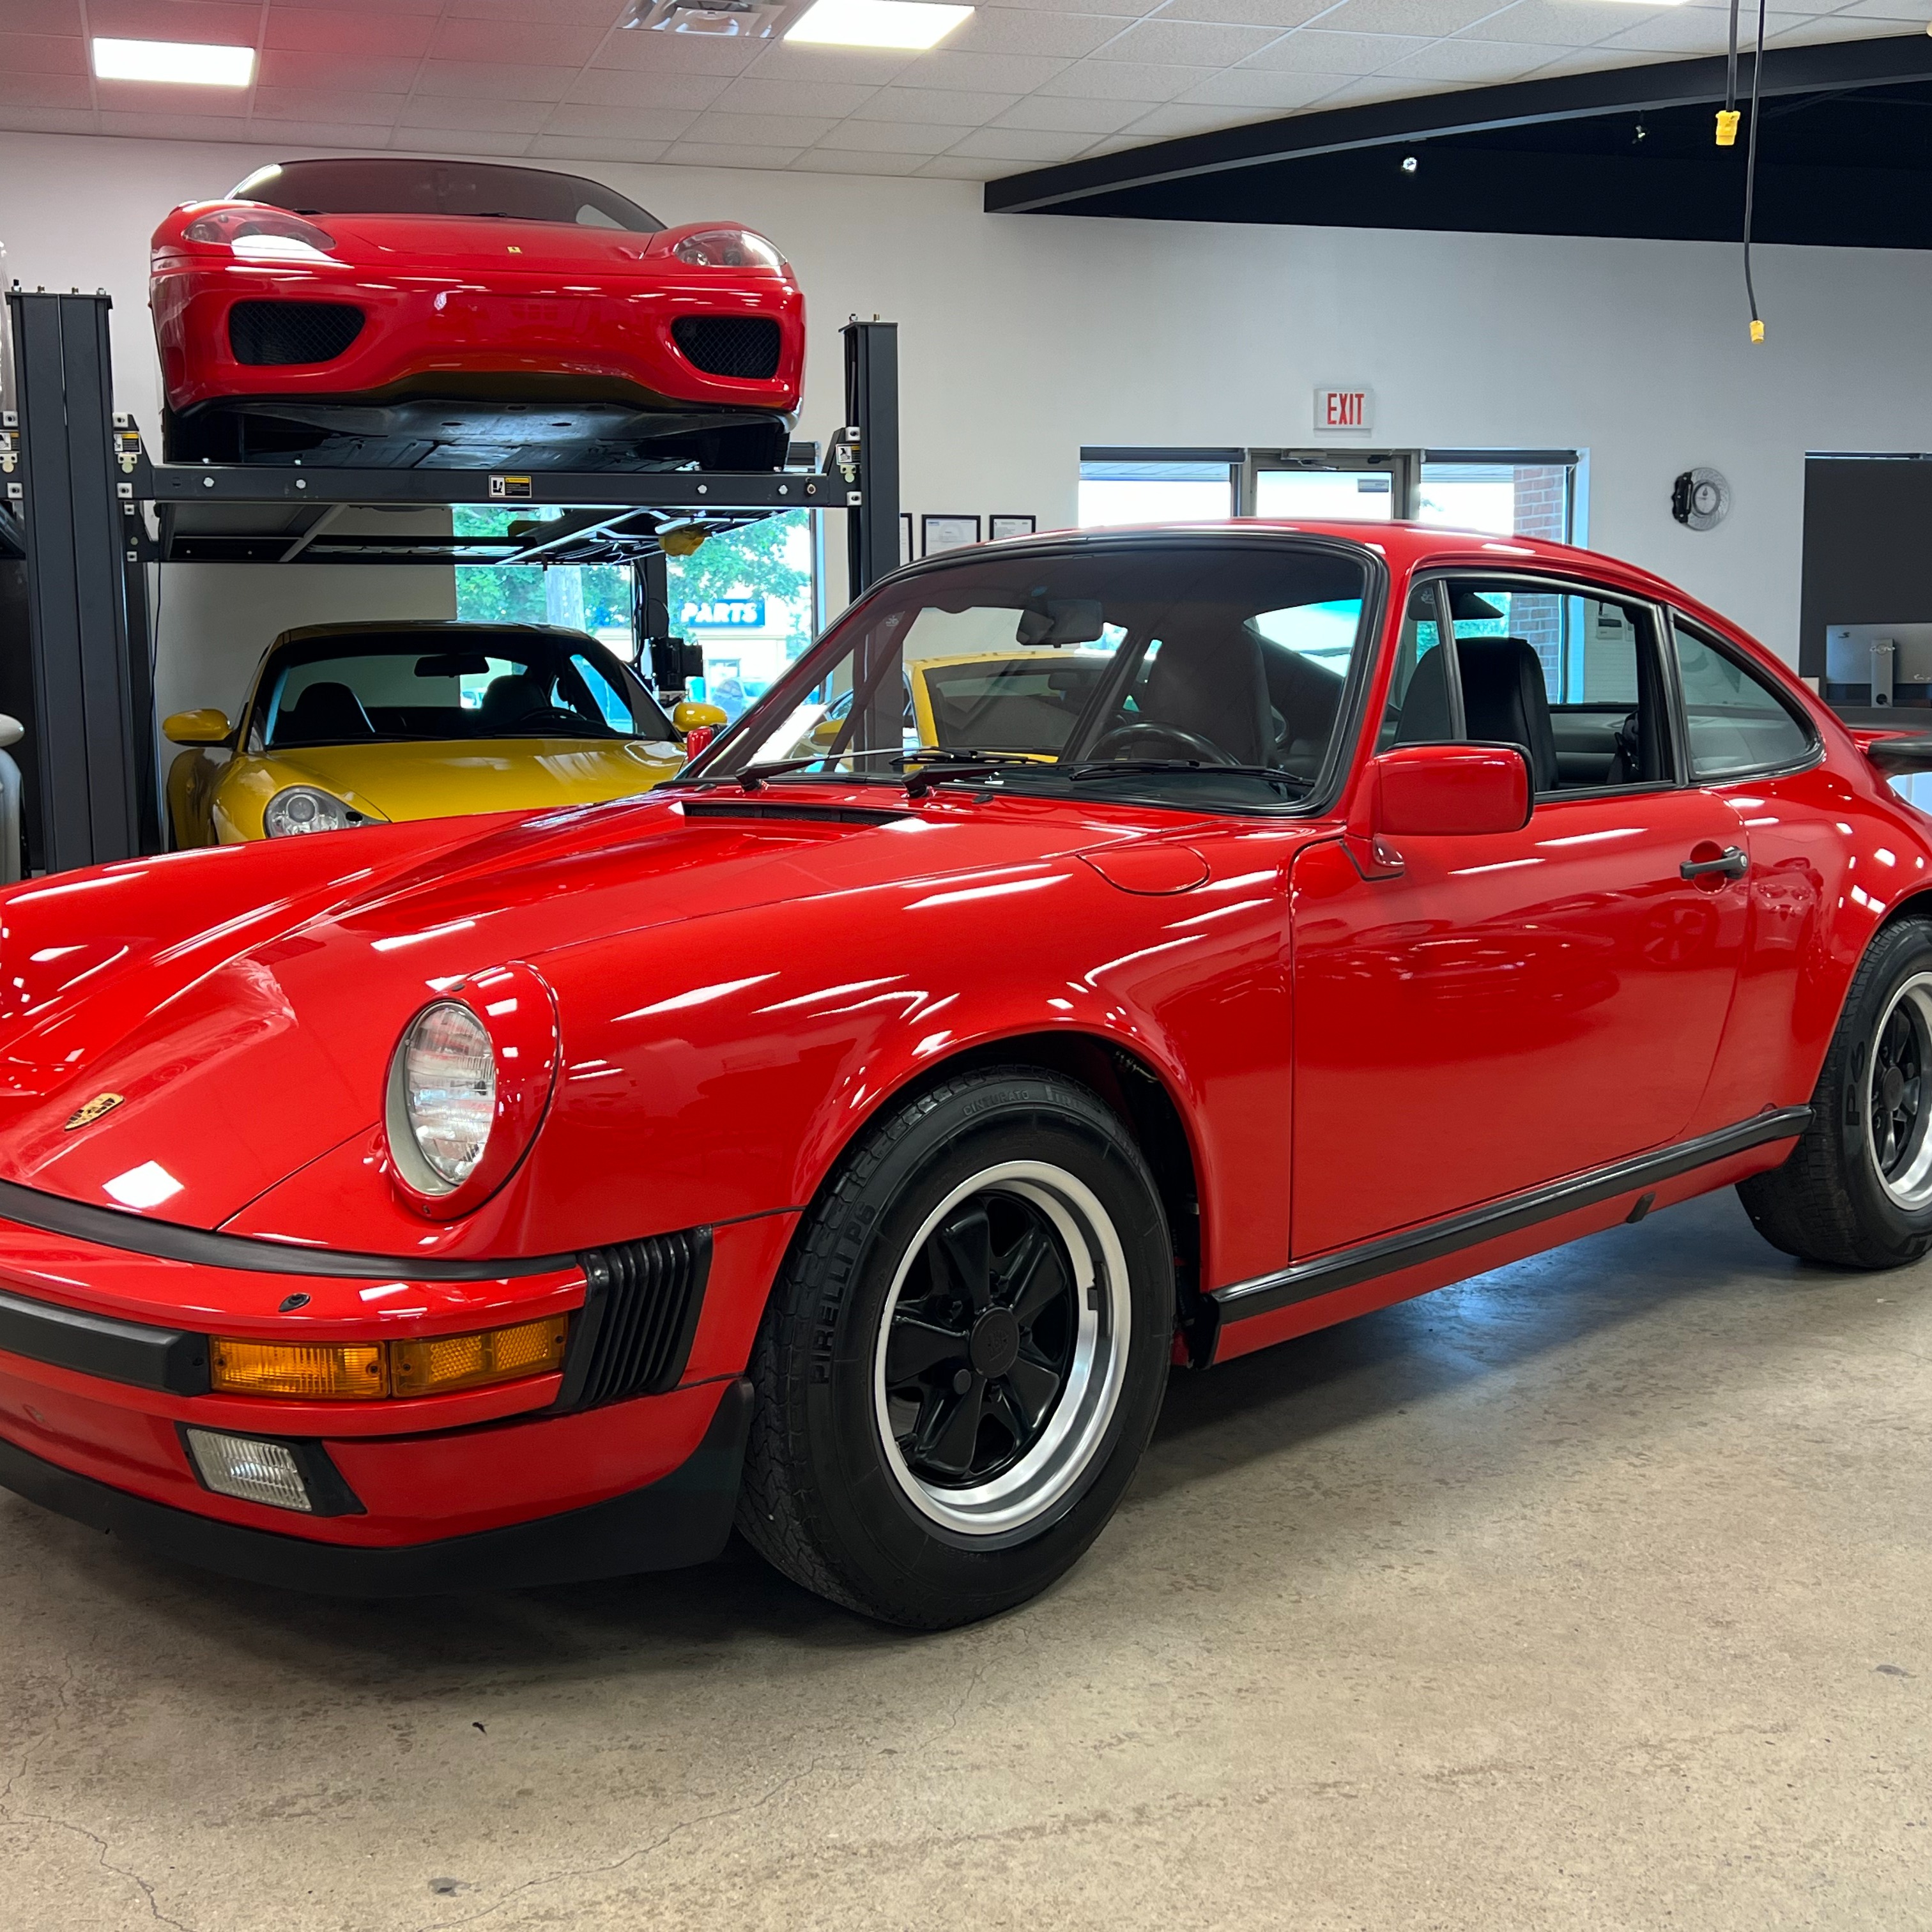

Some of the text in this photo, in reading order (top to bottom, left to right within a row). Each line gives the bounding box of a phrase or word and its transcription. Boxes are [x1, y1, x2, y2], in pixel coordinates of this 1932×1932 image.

[1328, 393, 1365, 425] EXIT
[680, 602, 757, 622] PARTS
[1845, 1041, 1866, 1126] P6
[809, 1252, 855, 1384] PIRELLI
